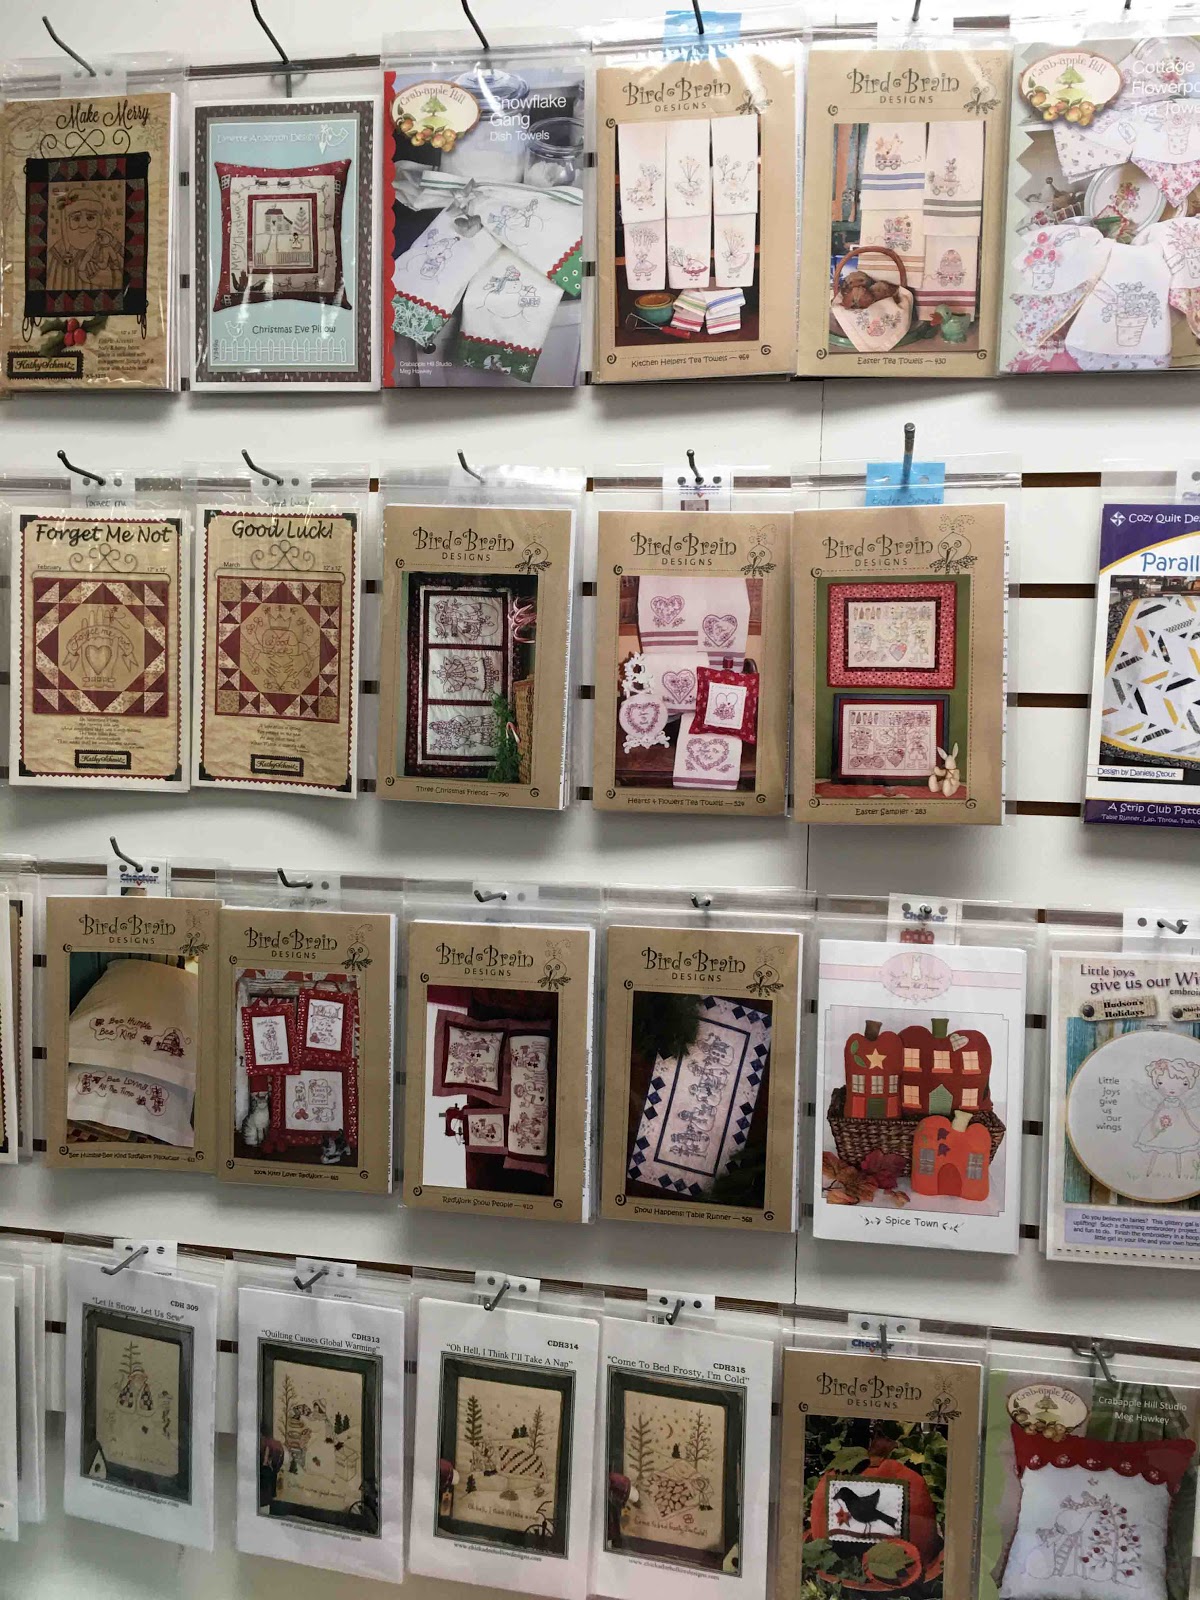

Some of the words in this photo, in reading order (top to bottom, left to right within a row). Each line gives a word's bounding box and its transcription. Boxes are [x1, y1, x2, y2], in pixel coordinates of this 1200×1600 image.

[1088, 58, 1108, 76] Hill
[1131, 59, 1195, 76] Cottage
[449, 88, 467, 105] Hill
[879, 95, 934, 105] DESIGNS
[654, 102, 708, 113] DESIGNS
[56, 104, 100, 131] Make
[102, 100, 149, 127] Merry
[490, 112, 531, 130] Gang
[515, 130, 550, 142] Towels
[252, 325, 293, 335] Christmas
[294, 325, 310, 334] Eve
[631, 359, 659, 368] Kitchen
[688, 356, 702, 364] Tea
[703, 355, 728, 363] Towels
[857, 357, 881, 365] Easter
[882, 357, 897, 365] Tea
[898, 357, 924, 365] Towels
[1128, 513, 1154, 523] Cozy
[1155, 513, 1182, 524] Quilt
[1184, 513, 1200, 524] De
[35, 523, 103, 547] Forget
[106, 525, 135, 543] Me
[137, 525, 173, 543] Not
[231, 519, 284, 539] Good
[287, 520, 334, 539] Luck!
[441, 552, 491, 562] DESIGNS
[661, 557, 713, 566] DESIGNS
[854, 557, 908, 567] DESIGNS
[1140, 552, 1200, 573] Parall
[37, 563, 62, 572] February
[1097, 767, 1120, 776] Design
[1120, 768, 1130, 776] by
[1130, 769, 1155, 777] Daniela
[1155, 770, 1177, 778] Stout
[415, 785, 434, 793] Three
[466, 788, 489, 796] Friends
[627, 797, 651, 805] Hearts
[658, 798, 684, 806] Flowers
[700, 799, 724, 807] Towels
[1107, 802, 1118, 812] A
[1120, 803, 1145, 813] Strip
[1147, 804, 1172, 814] Club
[855, 807, 879, 816] Easter
[880, 807, 909, 816] Sampler
[903, 911, 948, 923] Cheker
[108, 936, 155, 945] DESIGNS
[271, 950, 317, 959] DESIGNS
[464, 967, 512, 977] DESIGNS
[671, 972, 722, 982] DESIGNS
[1080, 964, 1110, 976] Little
[1111, 966, 1136, 979] joys
[1090, 978, 1122, 995] give
[1125, 979, 1143, 990] us
[1146, 977, 1171, 988] our
[1175, 971, 1200, 987] Wi
[1103, 1000, 1145, 1009] Hudson's
[1104, 1009, 1145, 1019] Holidays
[1098, 1077, 1120, 1085] Little
[1101, 1087, 1121, 1098] joys
[1099, 1097, 1118, 1107] give
[1096, 1122, 1122, 1133] wings
[491, 1200, 513, 1209] People
[634, 1206, 653, 1214] Snow
[685, 1210, 705, 1219] Table
[706, 1212, 732, 1221] Runner
[884, 1215, 911, 1227] Spice
[914, 1217, 939, 1229] Town
[1141, 1231, 1173, 1240] embroidery
[1145, 1225, 1177, 1234] embroidery
[115, 1301, 139, 1313] Snow,
[140, 1306, 153, 1316] Let
[154, 1308, 164, 1318] Us
[170, 1299, 185, 1309] CDH
[186, 1303, 199, 1312] 309
[294, 1333, 319, 1344] Causes
[319, 1336, 344, 1348] Global
[351, 1332, 381, 1344] CDH313
[547, 1339, 580, 1351] CDH314
[462, 1344, 481, 1356] Hell,
[487, 1348, 509, 1360] Think
[511, 1351, 523, 1362] I'll
[524, 1354, 543, 1365] Take
[545, 1357, 552, 1366] A
[638, 1360, 650, 1370] To
[652, 1361, 671, 1373] Bed
[672, 1365, 705, 1379] Frosty,
[707, 1370, 722, 1382] I'm
[713, 1362, 747, 1374] CDH315
[847, 1397, 899, 1410] DESIGNS
[1062, 1391, 1077, 1405] Hill
[1098, 1395, 1142, 1409] Crabapple
[1143, 1398, 1158, 1410] Hill
[1159, 1400, 1187, 1412] Studio
[1114, 1411, 1134, 1423] Meg
[1136, 1412, 1170, 1426] Hawkey
